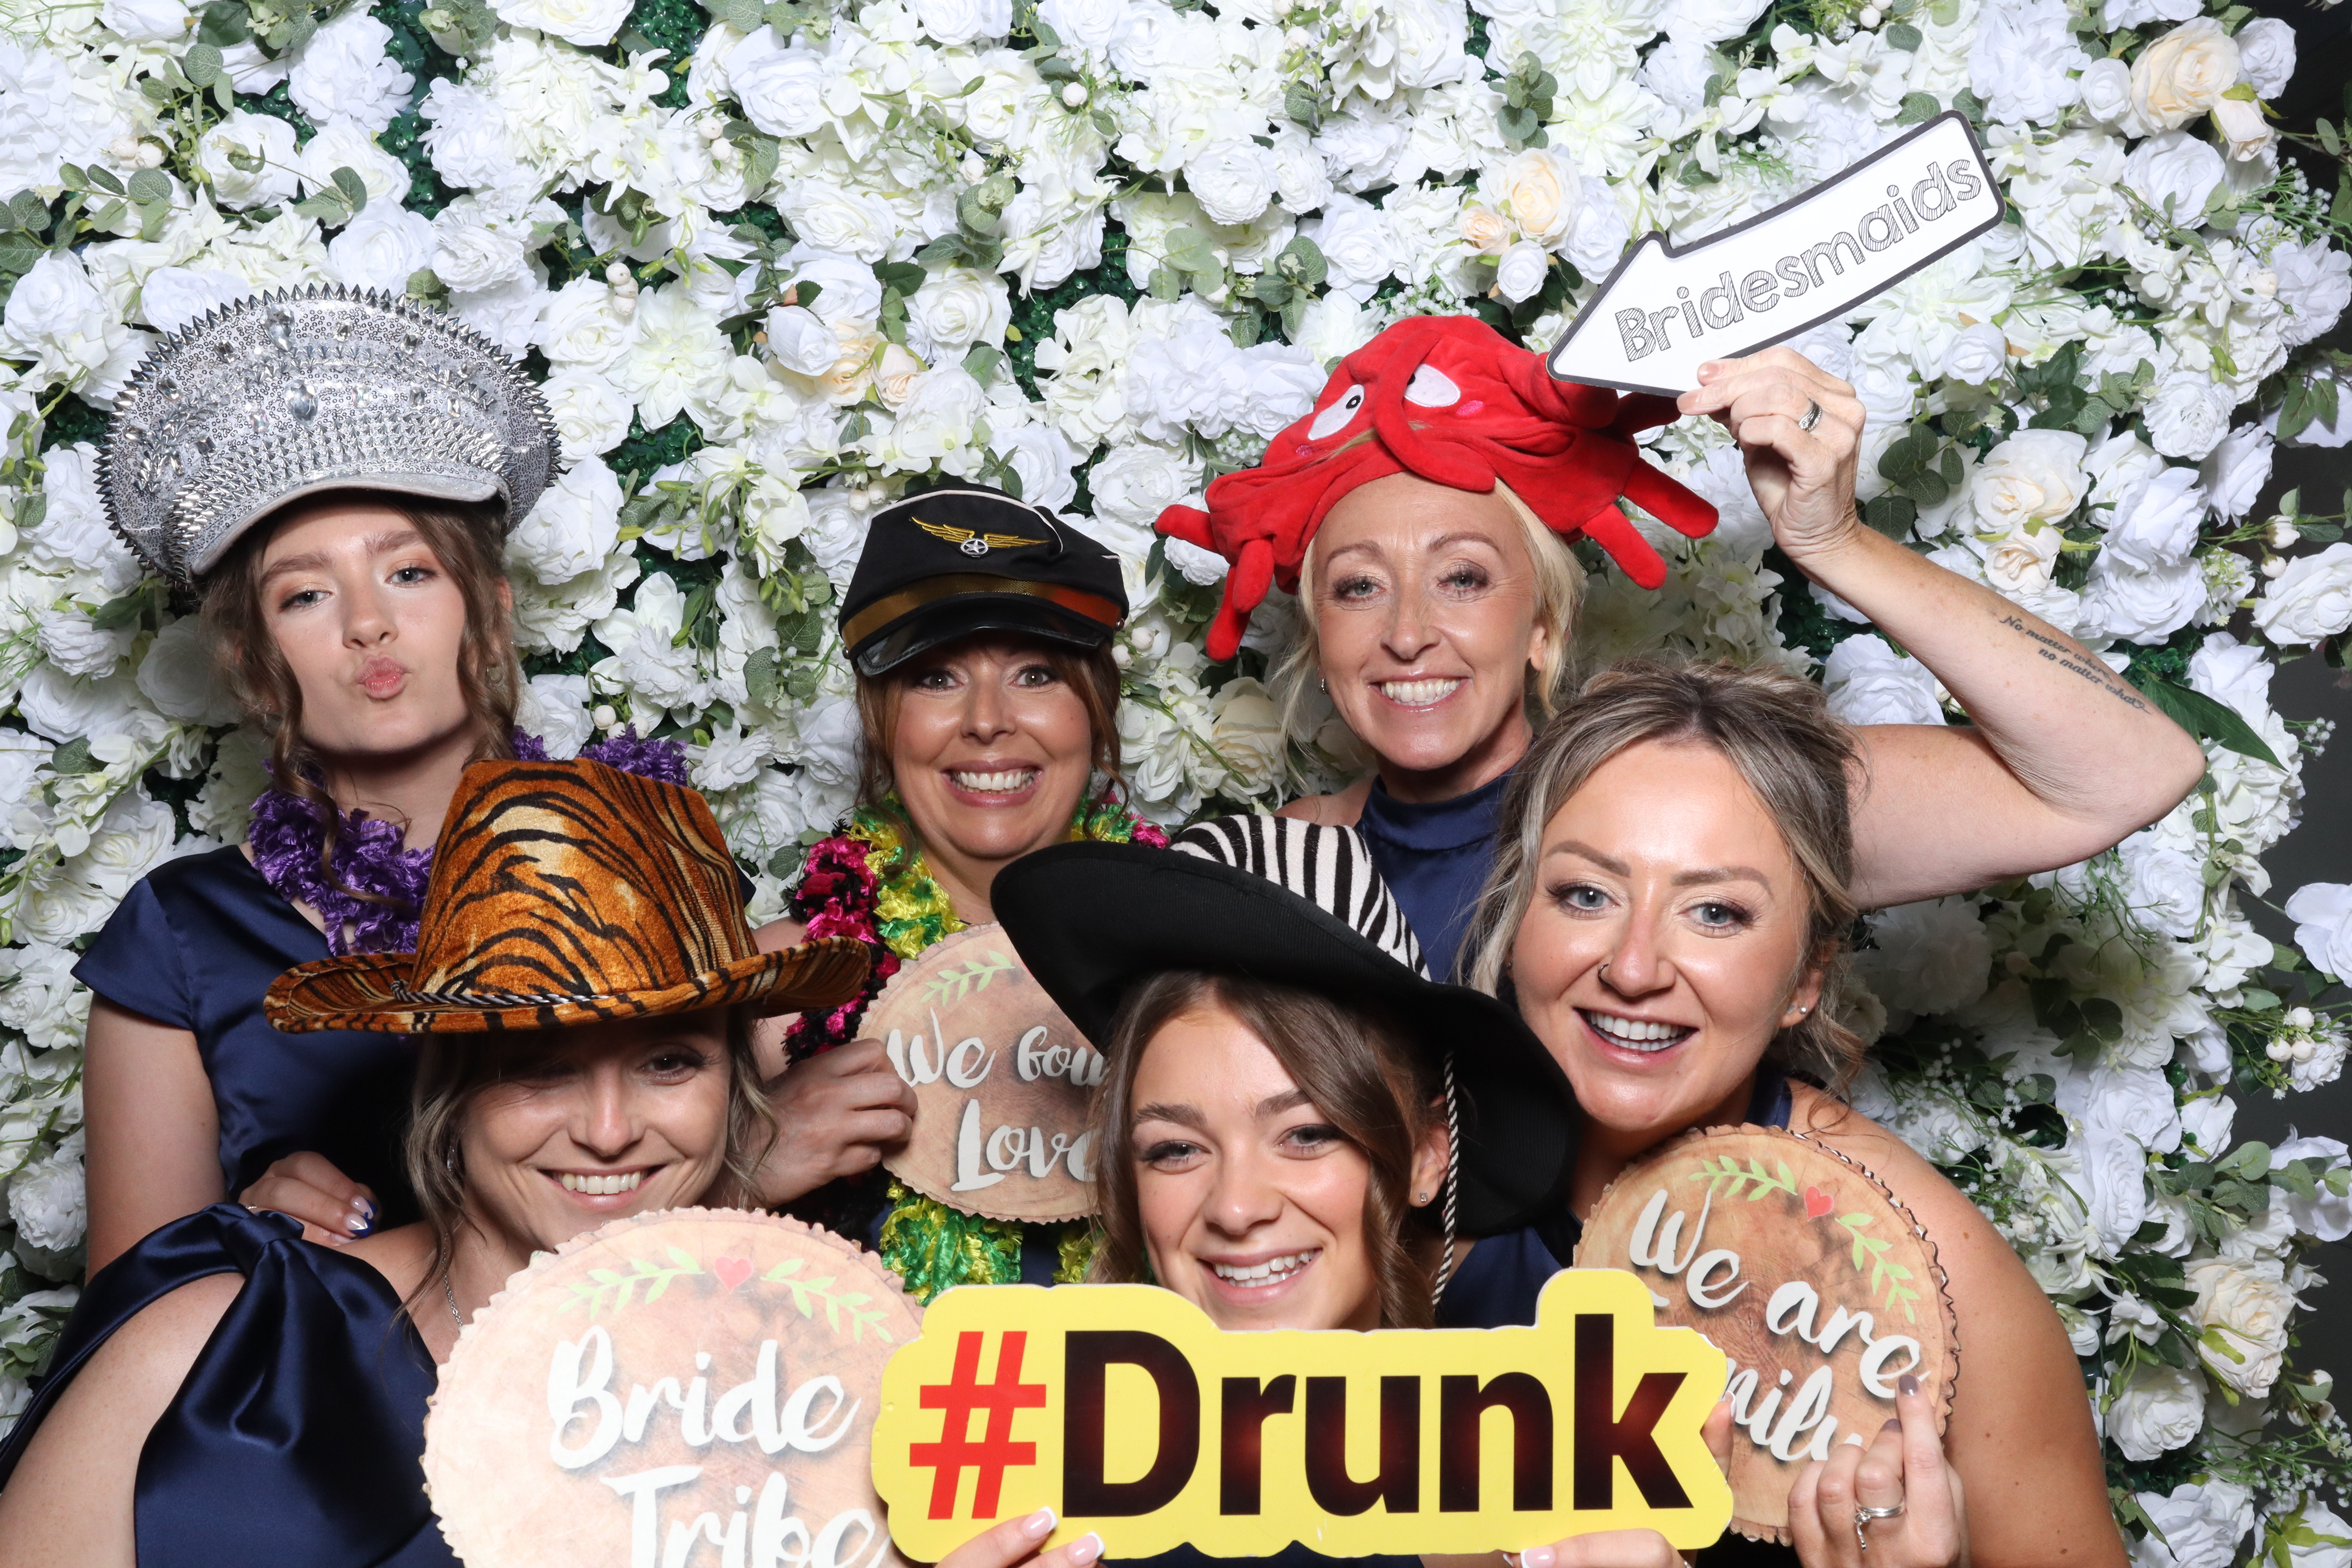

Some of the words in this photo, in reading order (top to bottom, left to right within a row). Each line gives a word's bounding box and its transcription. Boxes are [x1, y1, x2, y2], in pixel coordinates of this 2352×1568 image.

[1615, 159, 1982, 362] Bridesmaids
[2000, 615, 2024, 630] No
[2026, 630, 2072, 653] matter
[2039, 649, 2058, 660] no
[2060, 659, 2104, 684] matter
[2105, 684, 2151, 714] what
[886, 1007, 996, 1088] We
[1017, 1025, 1105, 1086] fou
[1629, 1188, 1750, 1308] We
[1766, 1281, 1932, 1399] are
[549, 1325, 861, 1469] Bride
[909, 1313, 1694, 1520] #Drunk
[600, 1466, 891, 1568] Tribe
